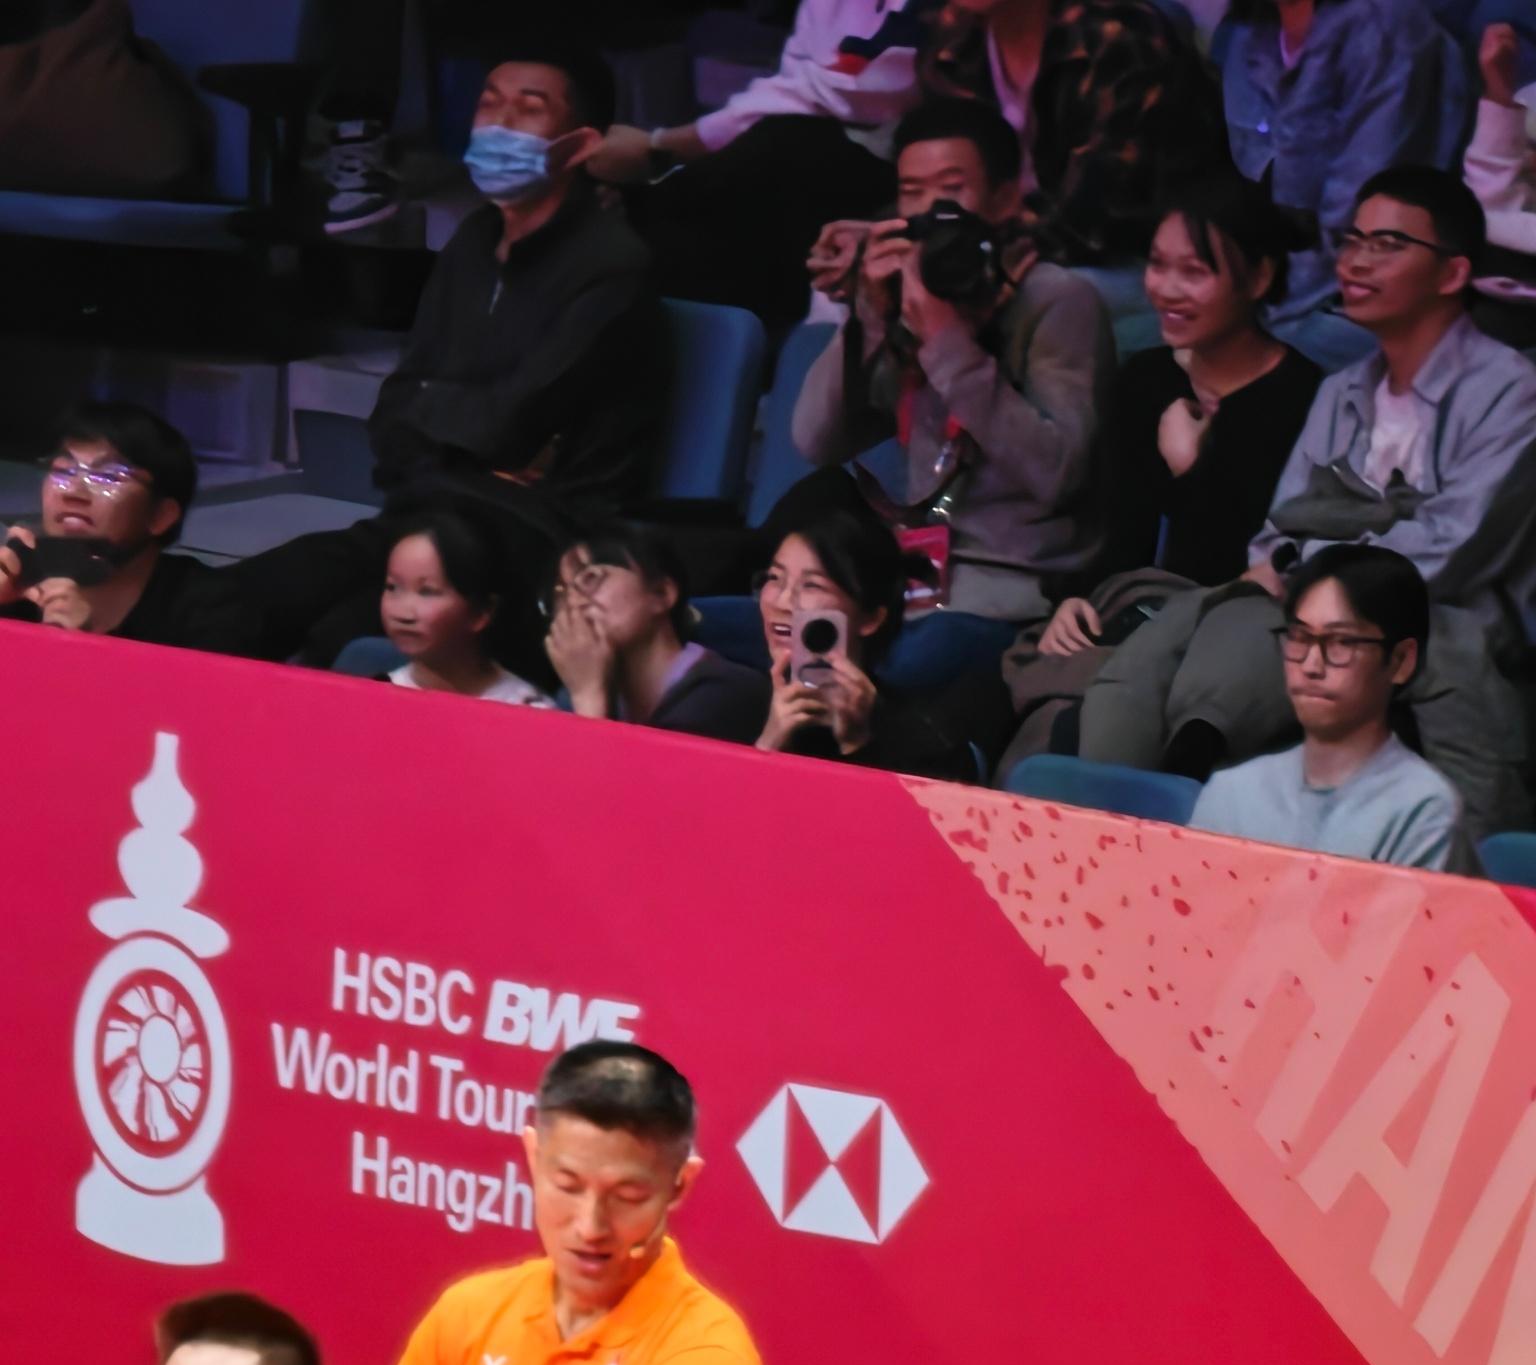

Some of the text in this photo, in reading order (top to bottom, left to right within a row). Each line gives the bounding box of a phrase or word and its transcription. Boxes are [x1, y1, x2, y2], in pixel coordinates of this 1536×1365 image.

[331, 947, 641, 1052] HSBC BWF
[271, 1022, 536, 1137] World Tour
[351, 1130, 535, 1234] Hangzh
